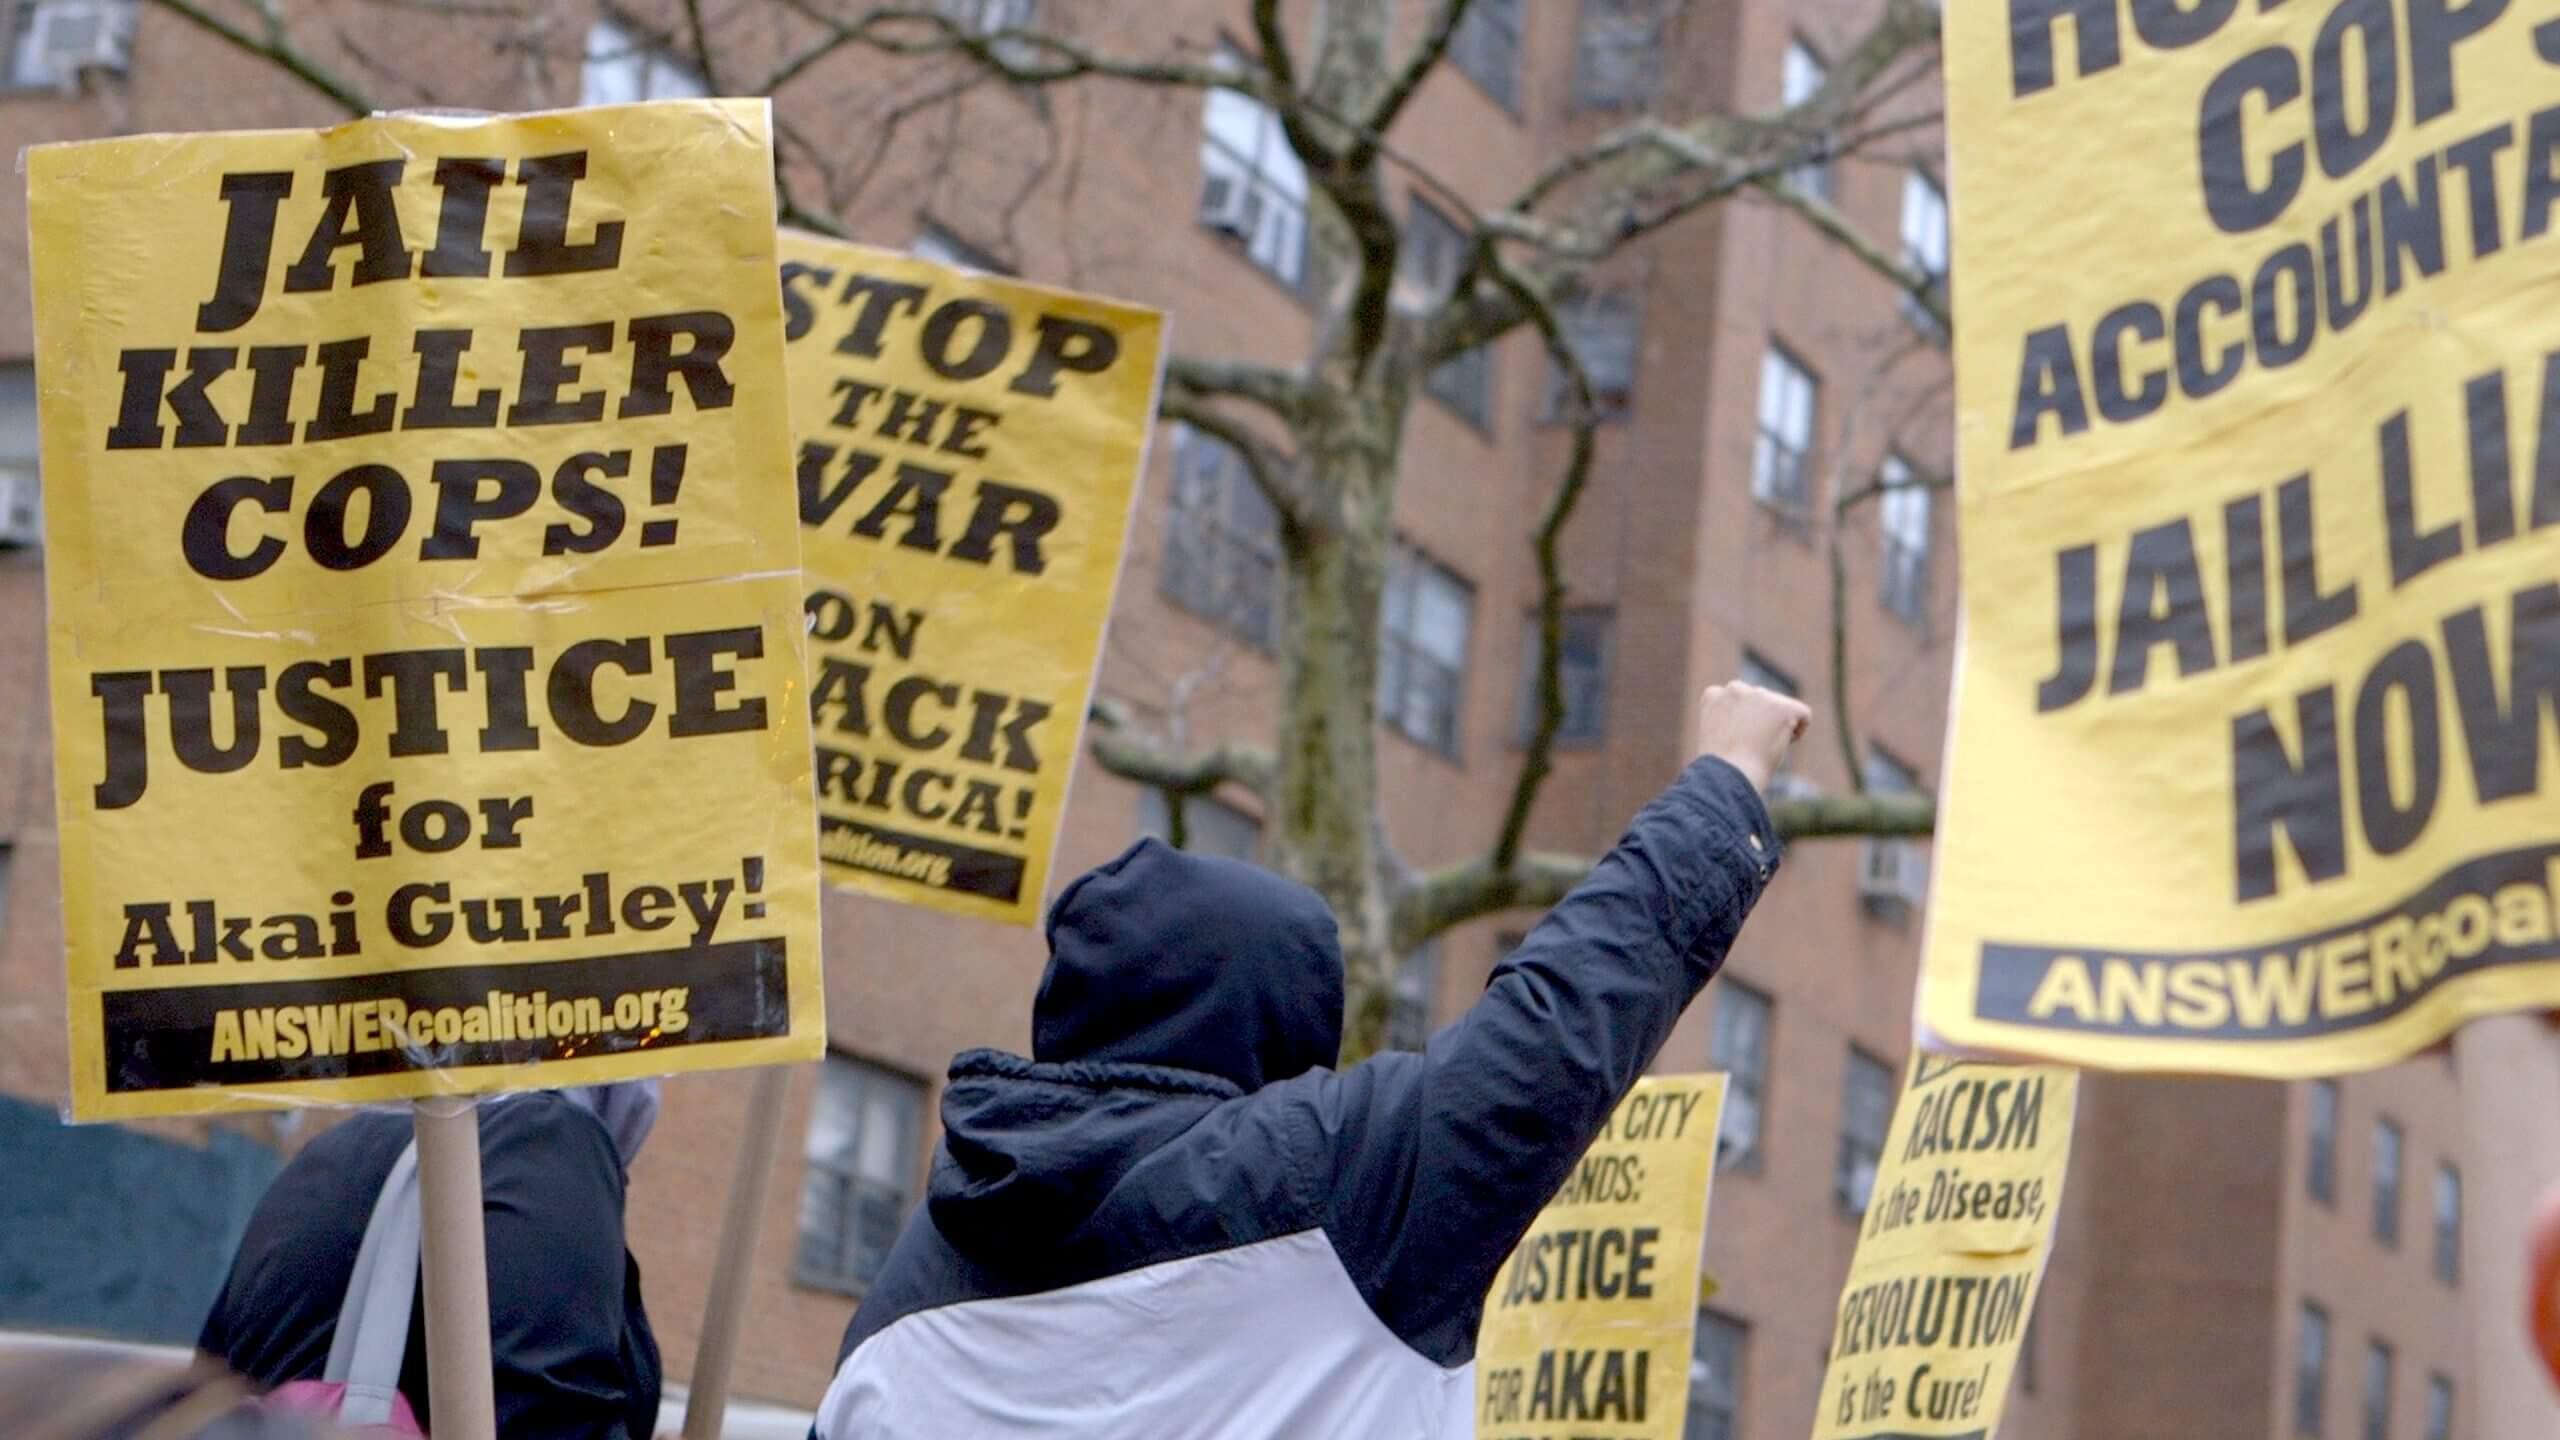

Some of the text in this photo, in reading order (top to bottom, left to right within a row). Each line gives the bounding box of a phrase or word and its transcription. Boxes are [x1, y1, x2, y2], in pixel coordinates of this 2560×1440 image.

[2197, 0, 2560, 234] COP
[196, 150, 625, 333] JAIL
[780, 261, 1118, 399] STOP
[106, 311, 735, 450] KILLER
[830, 379, 1002, 459] THE
[182, 444, 688, 581] COPS!
[804, 590, 924, 660] ON
[2037, 472, 2360, 712] JAIL
[91, 625, 768, 810] JUSTICE
[810, 655, 1053, 773] ACK
[2232, 581, 2560, 903] NOW
[352, 781, 533, 860] for
[816, 745, 1036, 841] RICA!
[114, 856, 768, 969] Akai Gurley!
[210, 986, 690, 1064] ANSWERcoalition.org
[1624, 1090, 1702, 1140] CITY
[1902, 1076, 2043, 1164] RACISM
[1925, 1168, 2045, 1226] Disease,
[1836, 1271, 2032, 1360] REVOLUTION
[1484, 1350, 1649, 1425] FOR AKAI
[1836, 1361, 1992, 1427] is the Cure!
